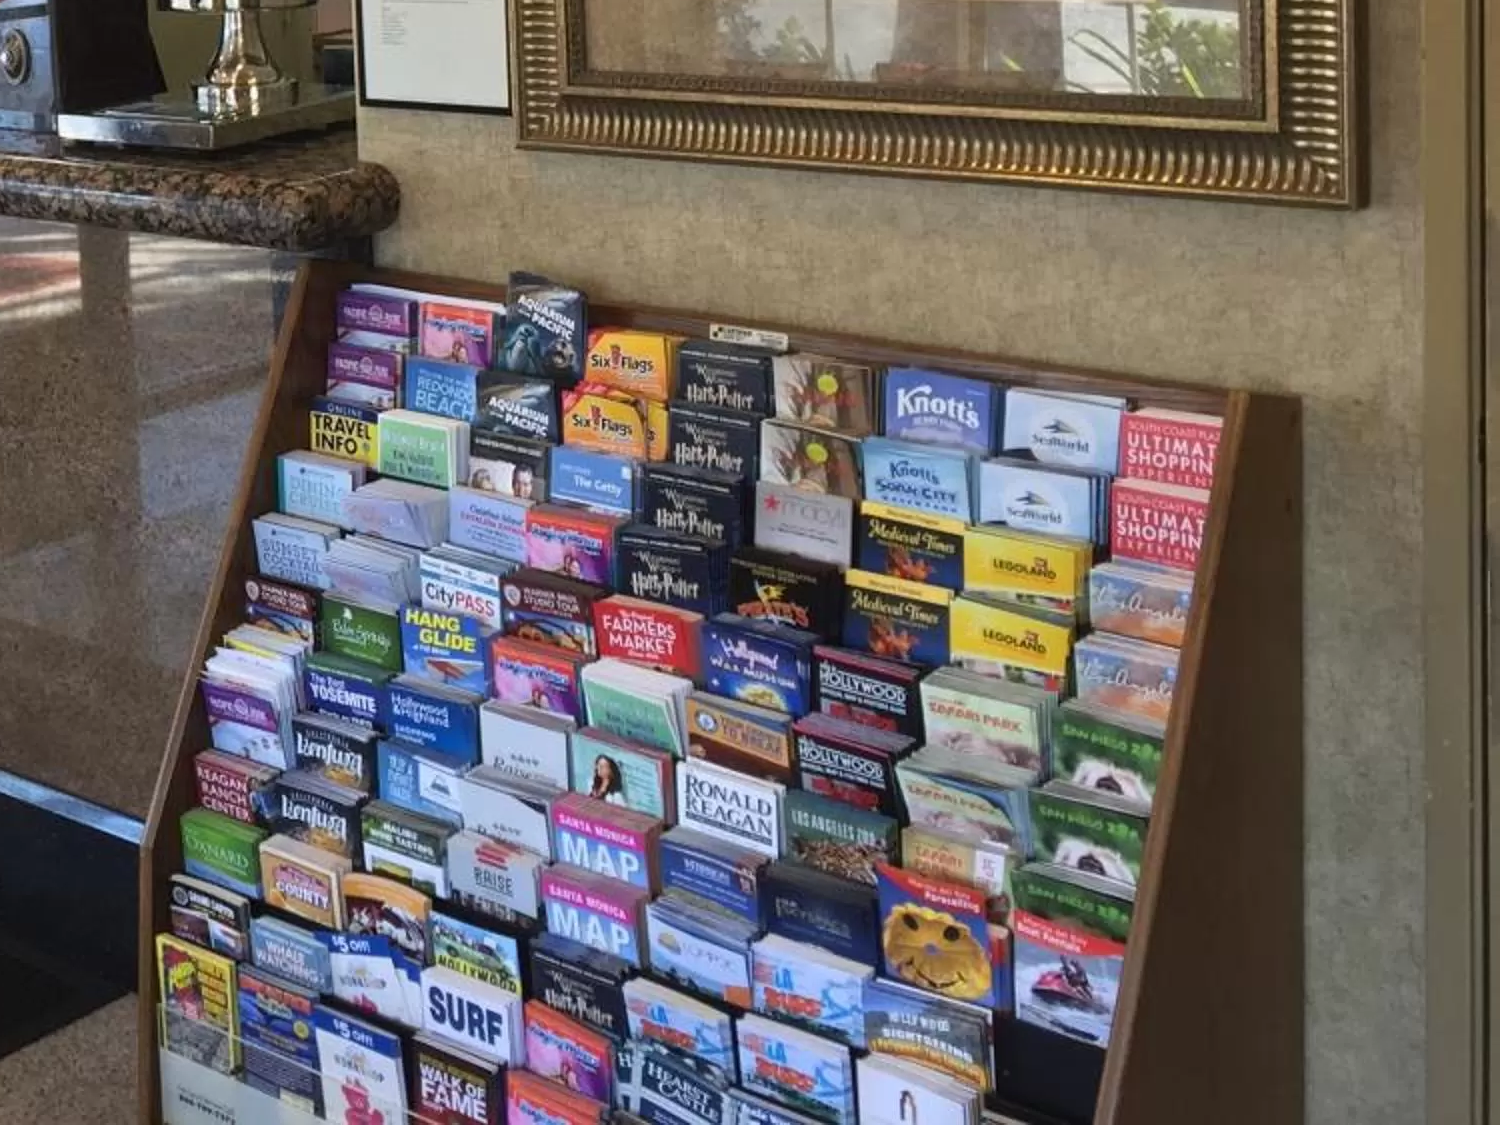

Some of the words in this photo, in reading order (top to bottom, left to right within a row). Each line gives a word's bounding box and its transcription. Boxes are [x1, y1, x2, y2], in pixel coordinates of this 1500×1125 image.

[518, 295, 575, 331] AQUARIUM
[531, 313, 573, 341] PACIFIC
[591, 354, 611, 368] Six
[622, 355, 654, 373] Flags
[415, 390, 476, 422] BEACH
[417, 378, 475, 405] REDONDO
[896, 384, 980, 428] Knott's
[327, 403, 363, 418] ONLINE
[489, 396, 549, 425] AQUARIUM
[504, 412, 548, 438] PACIFIC
[572, 414, 590, 428] Six
[601, 418, 633, 436] Flags
[314, 414, 371, 440] TRAVEL
[315, 432, 357, 455] INFO
[1031, 432, 1090, 453] SeaWorld
[574, 476, 592, 488] The
[594, 481, 622, 498] Getty
[1006, 506, 1063, 525] SeaWorld
[993, 558, 1056, 580] LEGOLAND
[425, 582, 496, 618] CityPASS
[405, 608, 460, 633] HANG
[603, 616, 677, 641] FARMERS
[419, 630, 477, 653] GLIDE
[609, 632, 674, 656] MARKET
[983, 628, 1047, 655] LEGOLAND
[311, 684, 377, 713] YOSEMITE
[819, 669, 907, 705] HOLLYWOOD
[296, 732, 364, 778] Ventura
[199, 768, 248, 792] REAGAN
[202, 784, 247, 805] RANCH
[685, 774, 772, 816] RONALD
[281, 794, 347, 841] Ventura
[685, 792, 772, 837] REAGAN
[558, 813, 592, 833] SANTA
[594, 826, 637, 846] MONICA
[559, 830, 639, 882] MAP
[275, 880, 329, 909] COUNTY
[549, 884, 584, 905] SANTA
[586, 896, 627, 920] MONICA
[551, 902, 630, 952] MAP
[264, 940, 305, 963] WHALE
[332, 935, 349, 953] $5
[438, 954, 517, 990] HOLLYWOOD
[428, 986, 503, 1045] SURF
[420, 1063, 465, 1091] WALK
[465, 1083, 485, 1100] OF
[648, 1062, 711, 1103] HEARST
[421, 1079, 488, 1125] FAME
[659, 1081, 719, 1122] CASTLE
